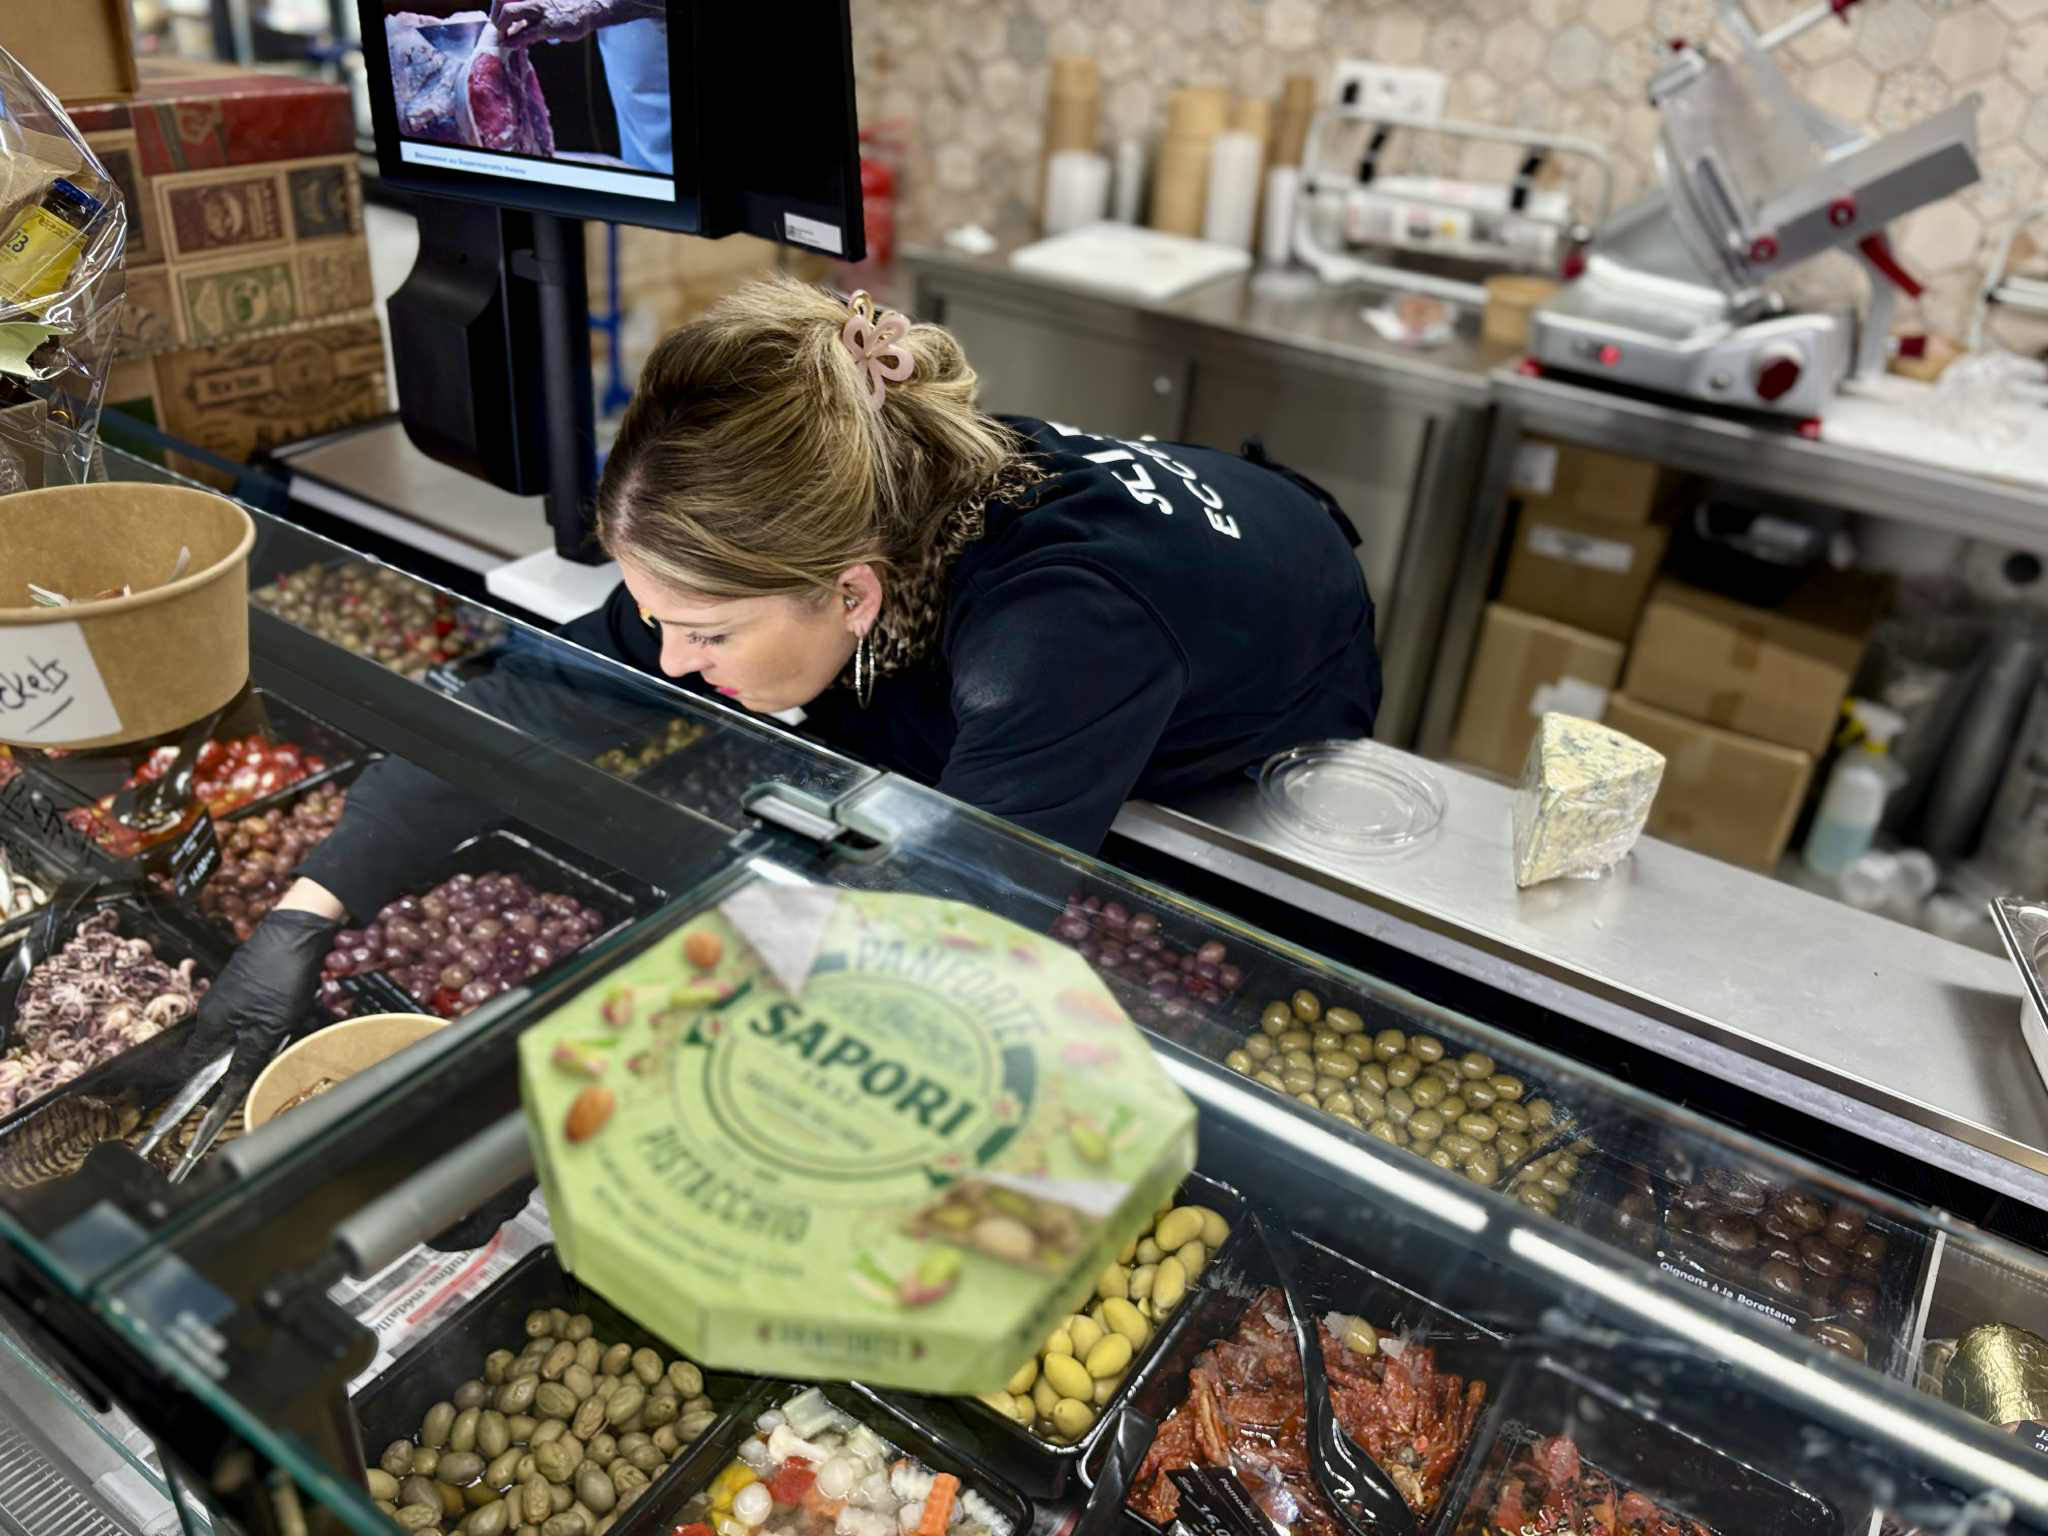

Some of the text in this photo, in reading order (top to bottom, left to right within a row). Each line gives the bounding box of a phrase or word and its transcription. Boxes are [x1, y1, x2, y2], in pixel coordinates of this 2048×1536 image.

[750, 1000, 977, 1136] SAPORI
[1660, 1261, 1708, 1289] Oignons
[1711, 1282, 1720, 1294] à
[1736, 1293, 1797, 1325] Borettane
